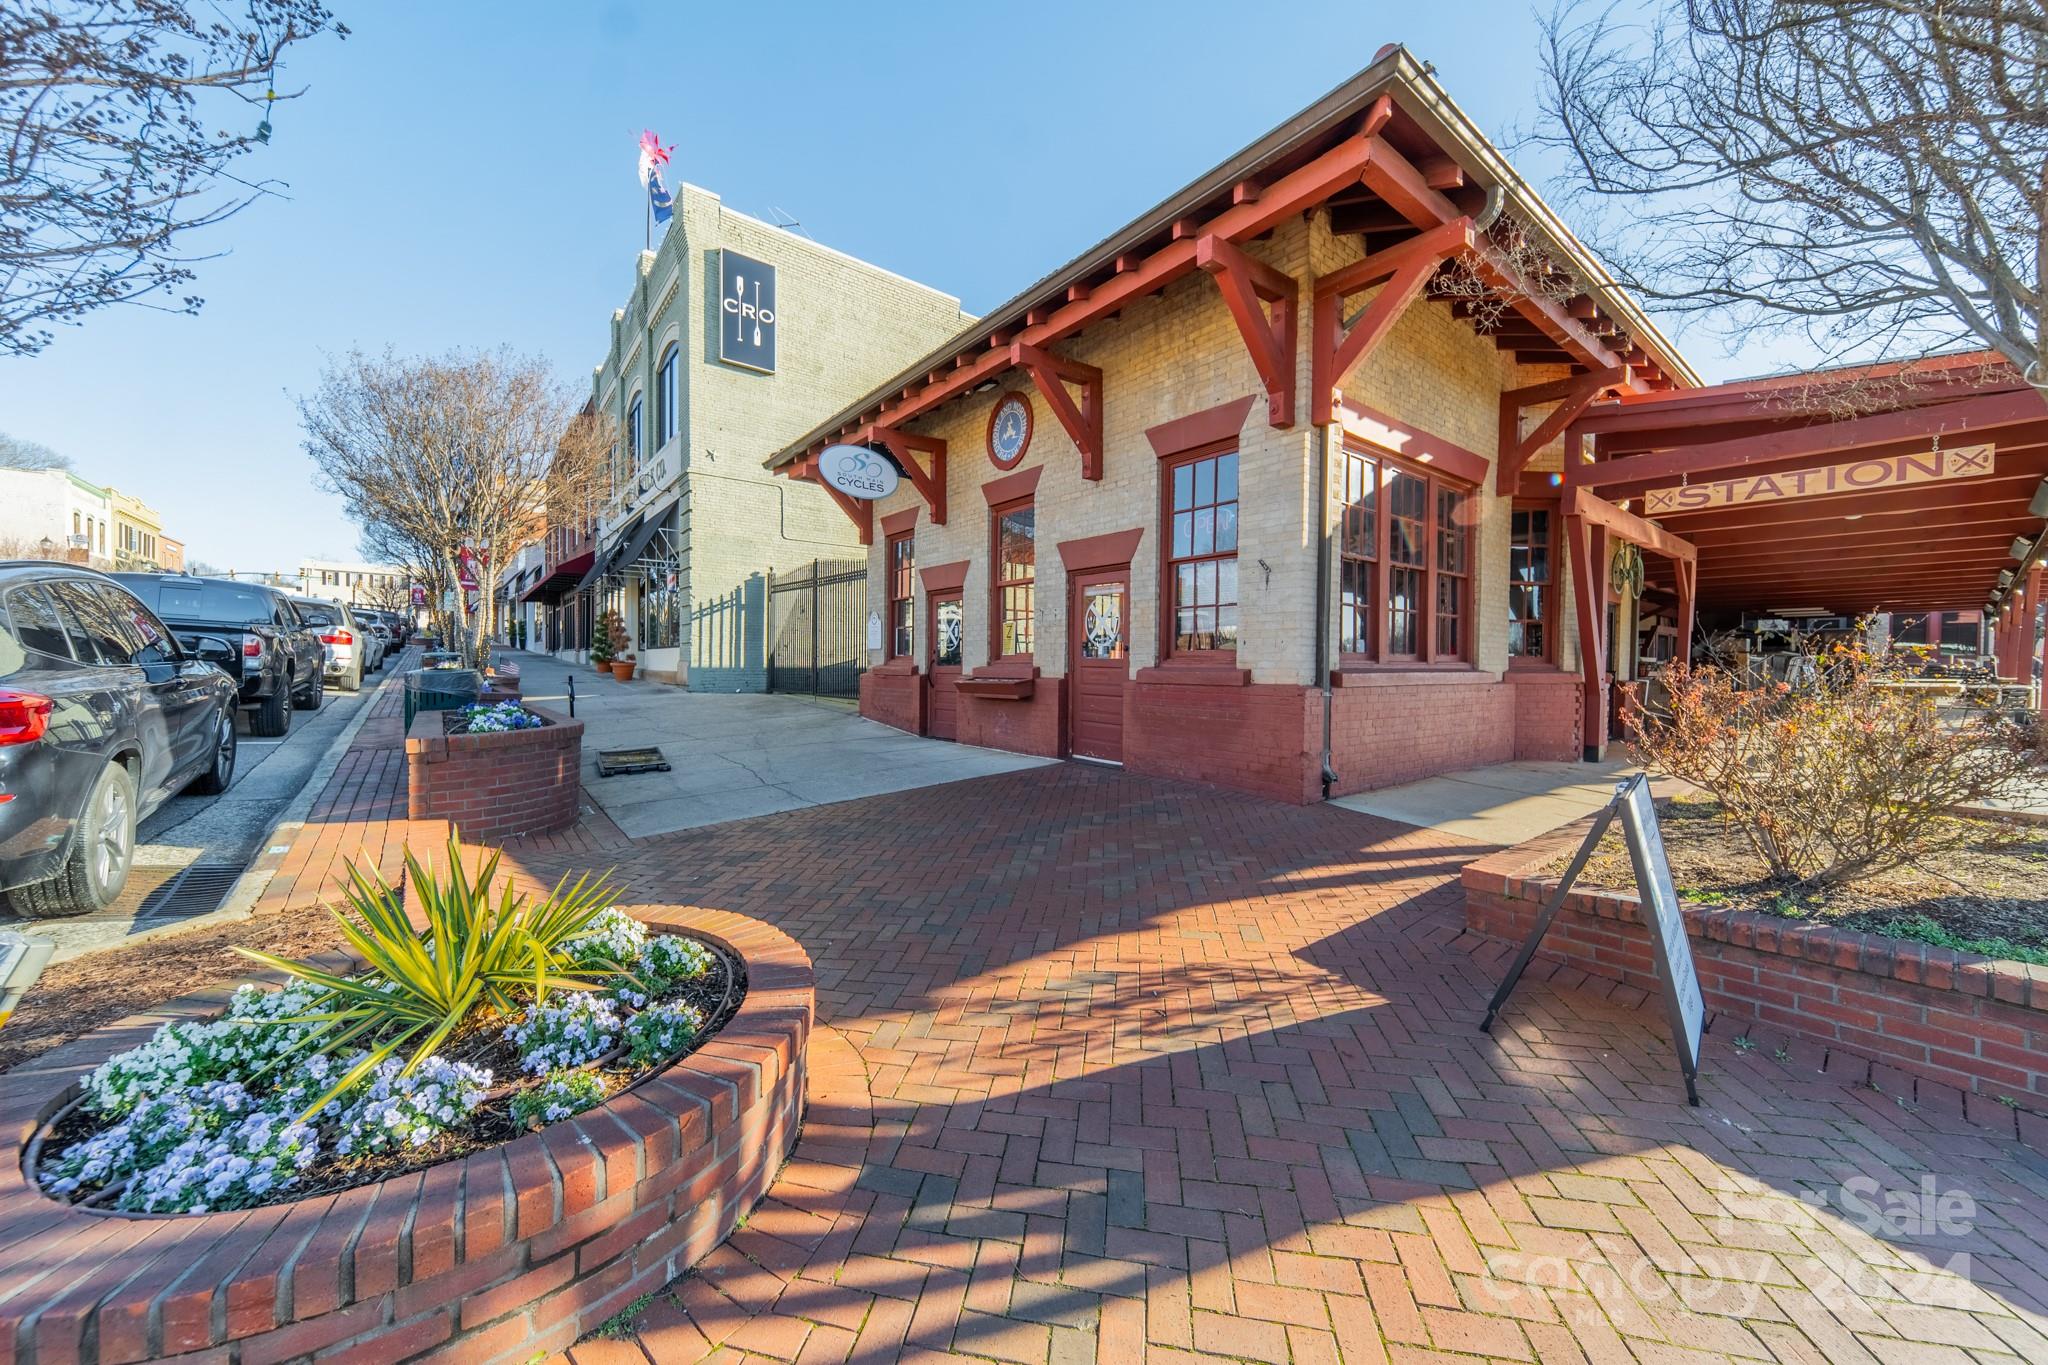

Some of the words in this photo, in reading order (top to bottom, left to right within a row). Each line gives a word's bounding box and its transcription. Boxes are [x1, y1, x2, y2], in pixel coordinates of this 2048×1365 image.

[724, 298, 775, 324] CRO
[837, 471, 863, 480] SOUTH
[866, 476, 884, 485] MAIN
[837, 476, 885, 493] CYCLES
[1677, 451, 1944, 509] STATION
[1184, 508, 1234, 538] OPEN
